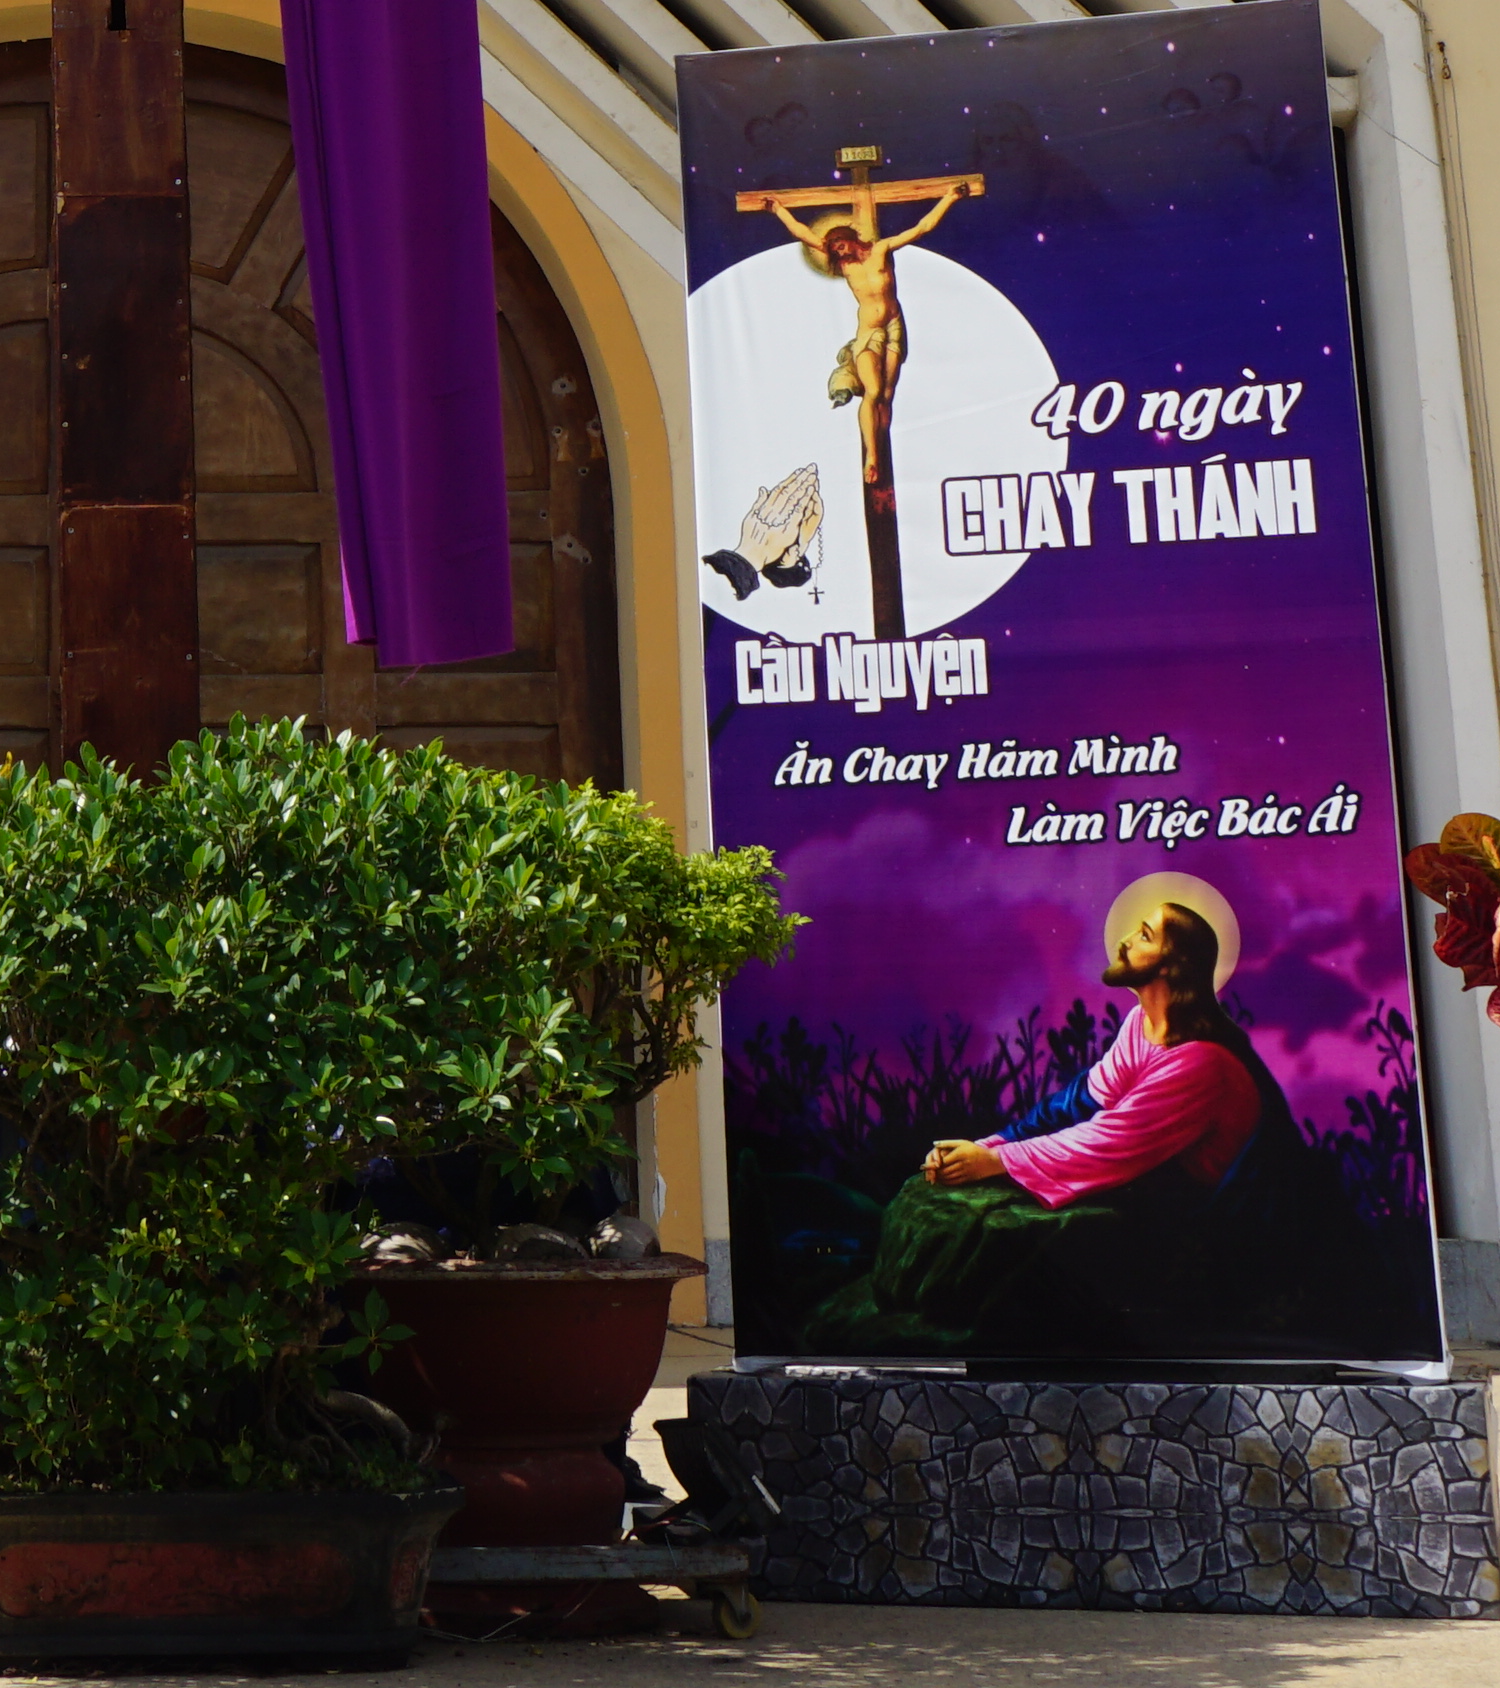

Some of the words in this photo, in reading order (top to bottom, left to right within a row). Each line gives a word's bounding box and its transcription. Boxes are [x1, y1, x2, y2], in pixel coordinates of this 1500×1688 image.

[1033, 381, 1126, 438] 40
[1137, 367, 1303, 441] ngày
[943, 471, 1096, 554] CHAY
[1112, 453, 1317, 544] THÁNH
[735, 634, 816, 705] Cầu
[824, 632, 989, 713] Nguyện
[774, 740, 833, 786] Ăn
[843, 746, 949, 790] Chay
[957, 739, 1059, 780] Hãm
[1067, 735, 1178, 776] Mình
[1006, 803, 1104, 844] Làm
[1118, 799, 1210, 849] Việc
[1216, 794, 1302, 837] Bác
[1307, 784, 1360, 834] Ái
